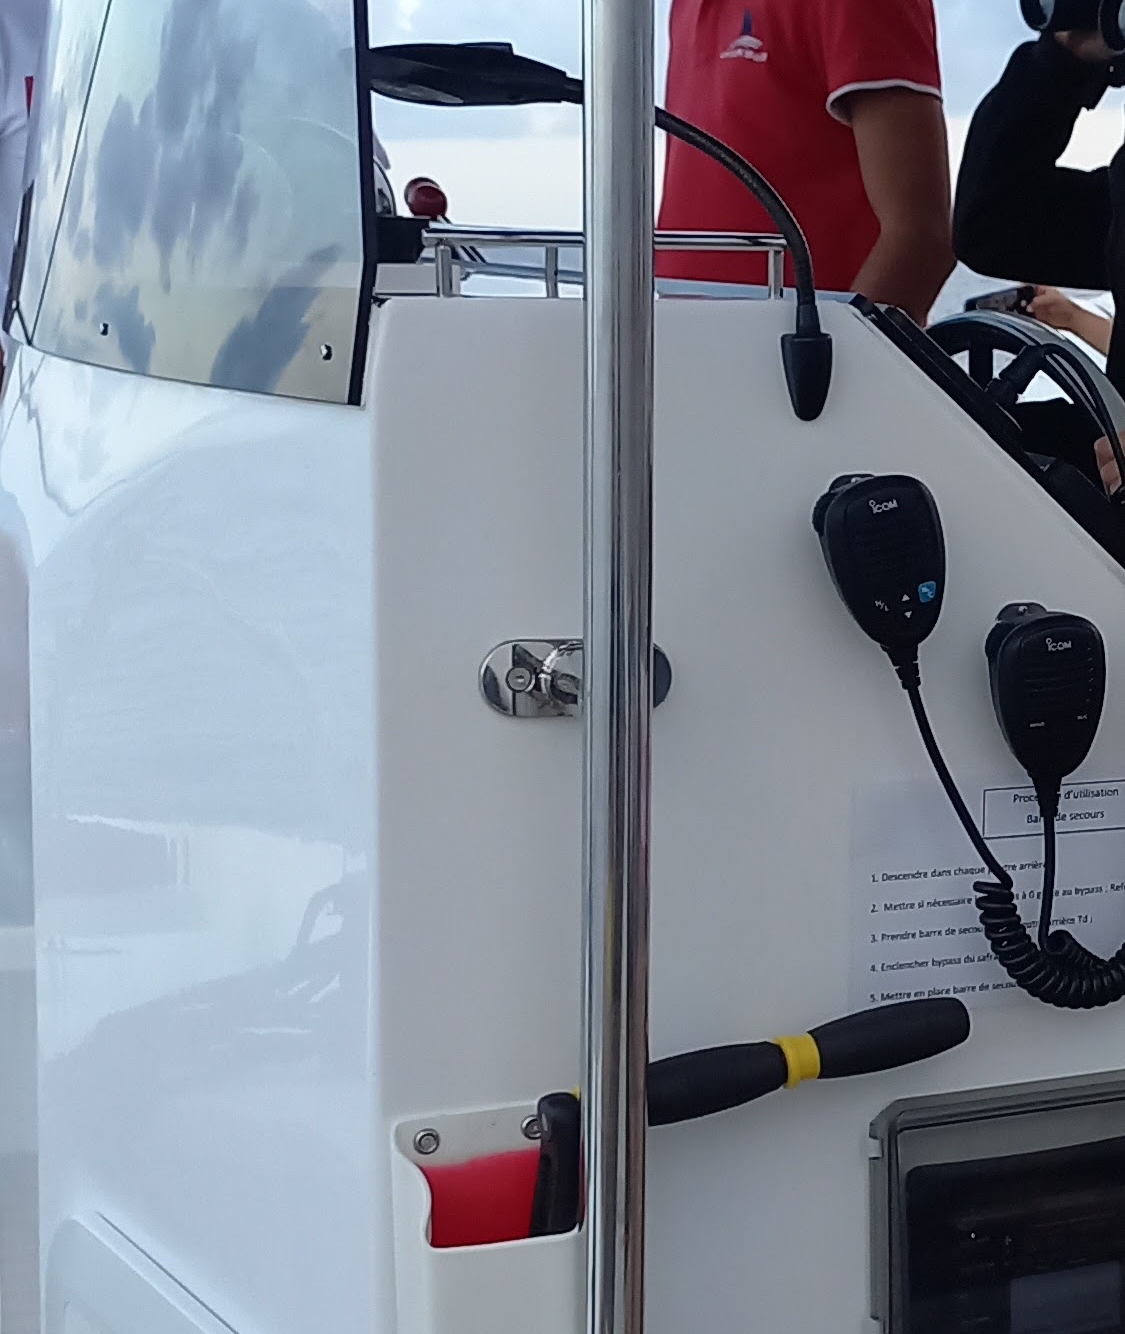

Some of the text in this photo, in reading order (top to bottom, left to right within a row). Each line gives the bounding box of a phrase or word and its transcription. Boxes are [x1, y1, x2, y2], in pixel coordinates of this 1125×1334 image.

[1064, 788, 1119, 800] d'utilisation
[1069, 810, 1105, 822] secours
[881, 870, 928, 882] Descendre
[931, 868, 952, 878] dans
[953, 866, 986, 876] chaque
[1019, 860, 1046, 871] arrièr
[883, 901, 916, 912] Mettre
[926, 898, 973, 909] nécessaire
[1061, 888, 1073, 897] au
[1074, 886, 1104, 897] bypass
[880, 930, 917, 942] Prendre
[918, 929, 943, 939] barre
[944, 927, 957, 935] de
[958, 926, 985, 935] secou
[880, 959, 930, 972] Enclencher
[931, 956, 962, 969] bypass
[963, 954, 976, 964] du
[880, 990, 912, 1002] Mettre
[913, 989, 926, 998] en
[927, 986, 951, 998] place
[952, 984, 977, 995] barre
[978, 982, 990, 992] de
